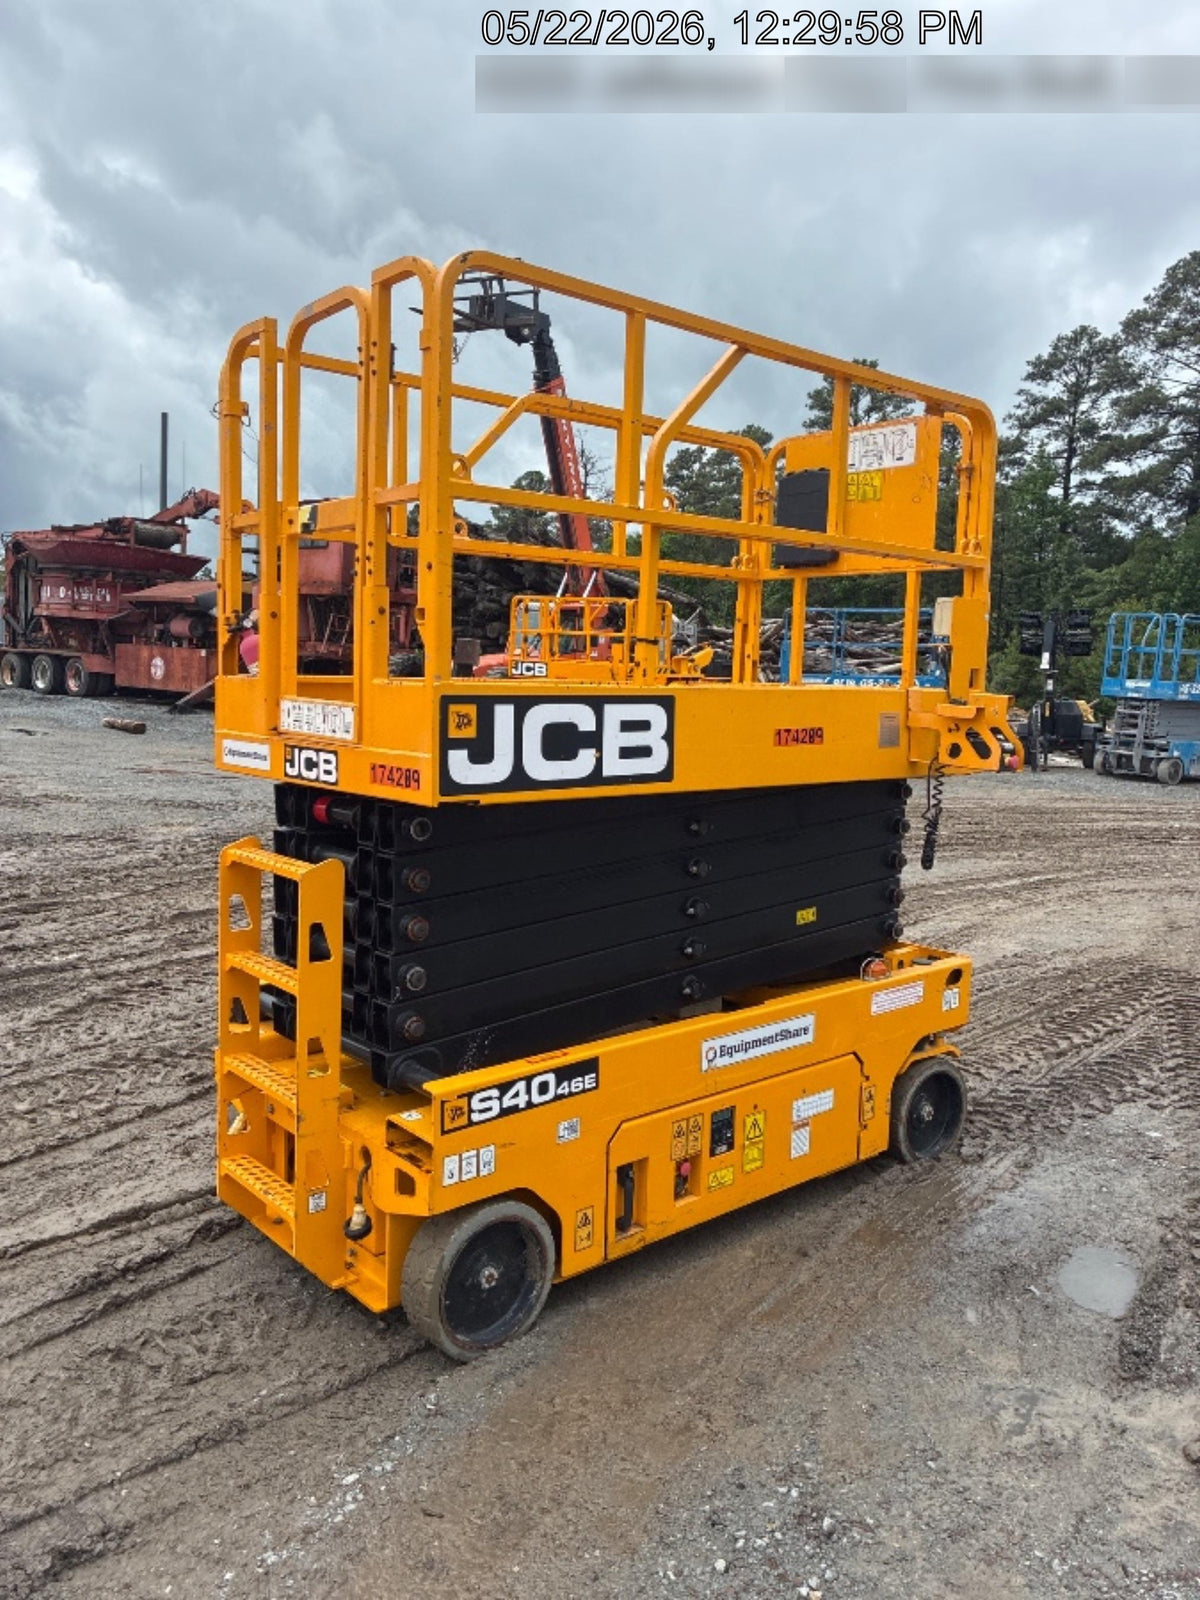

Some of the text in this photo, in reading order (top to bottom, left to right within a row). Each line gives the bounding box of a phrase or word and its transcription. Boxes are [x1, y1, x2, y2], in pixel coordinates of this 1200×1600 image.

[512, 661, 547, 676] JCB
[447, 703, 669, 784] JCB
[285, 748, 337, 783] JCB
[718, 1024, 810, 1059] EquipmentShare
